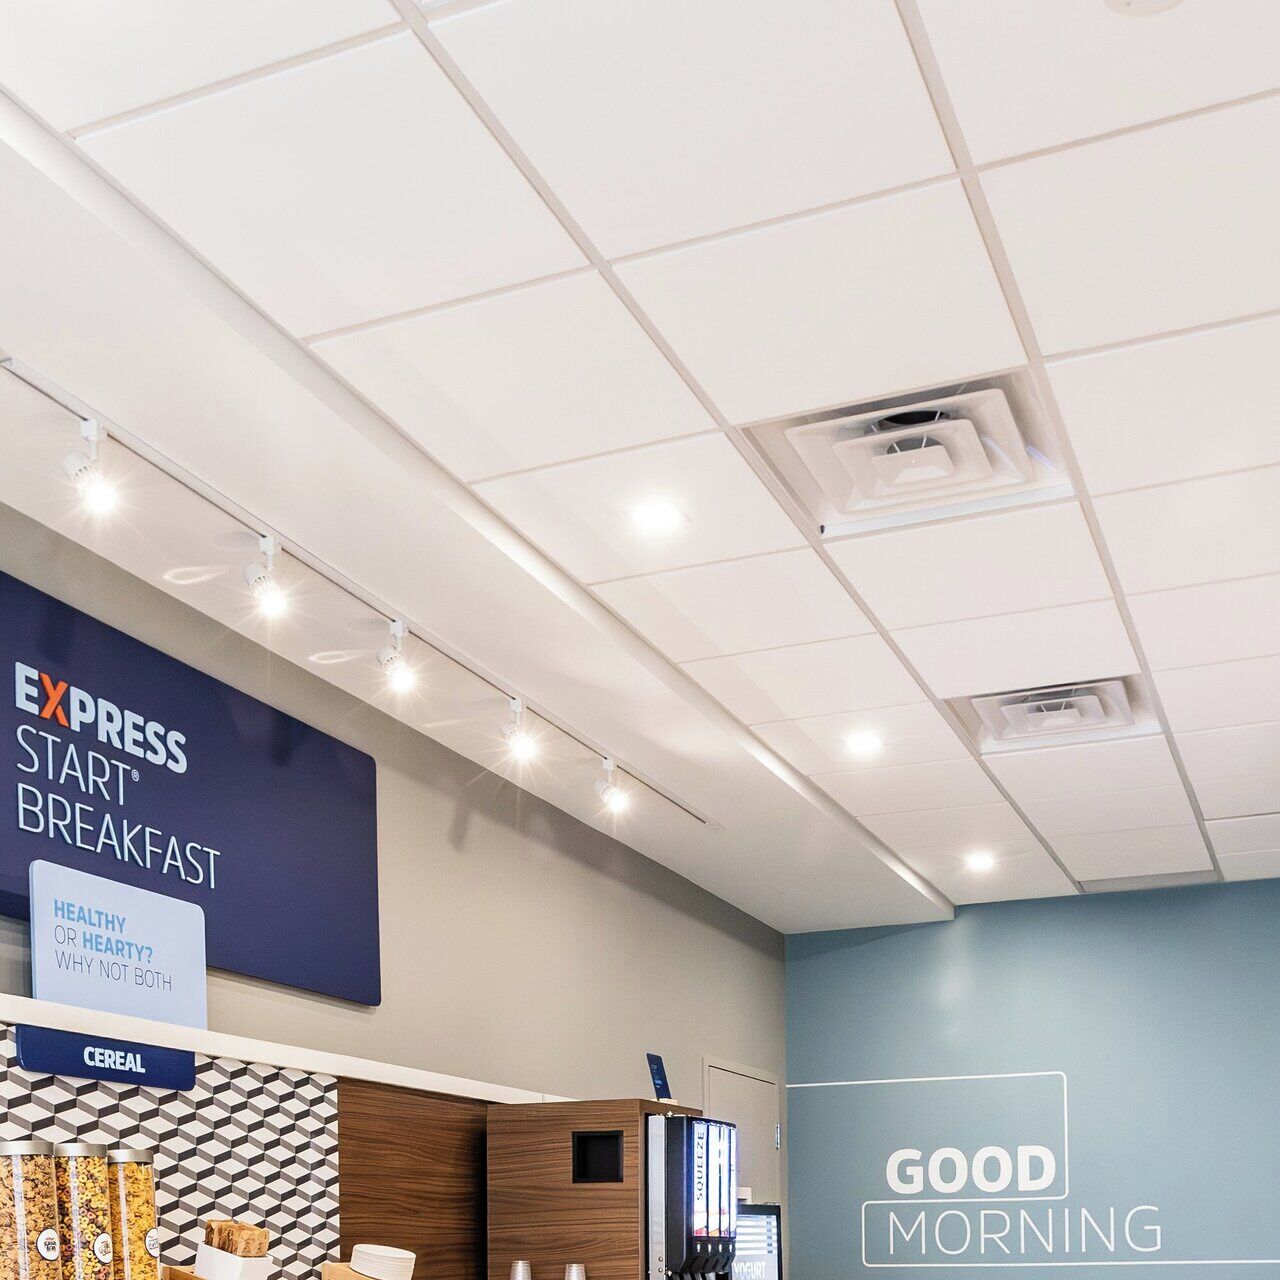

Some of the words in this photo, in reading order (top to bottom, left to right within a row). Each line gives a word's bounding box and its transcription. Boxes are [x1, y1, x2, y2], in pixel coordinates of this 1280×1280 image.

[15, 661, 188, 774] EXPRESS
[17, 782, 220, 889] BREAKFAST
[54, 898, 126, 934] HEALTHY
[54, 924, 77, 948] OR
[82, 930, 153, 964] HEARTY?
[55, 949, 94, 976] WHY
[99, 959, 129, 983] NOT
[134, 967, 172, 992] BOTH
[83, 1046, 146, 1074] CEREAL
[696, 1131, 705, 1201] SQUEEZE
[885, 1145, 1056, 1194] GOOD
[888, 1205, 1162, 1255] MORNING
[733, 1261, 767, 1280] YOGURT
